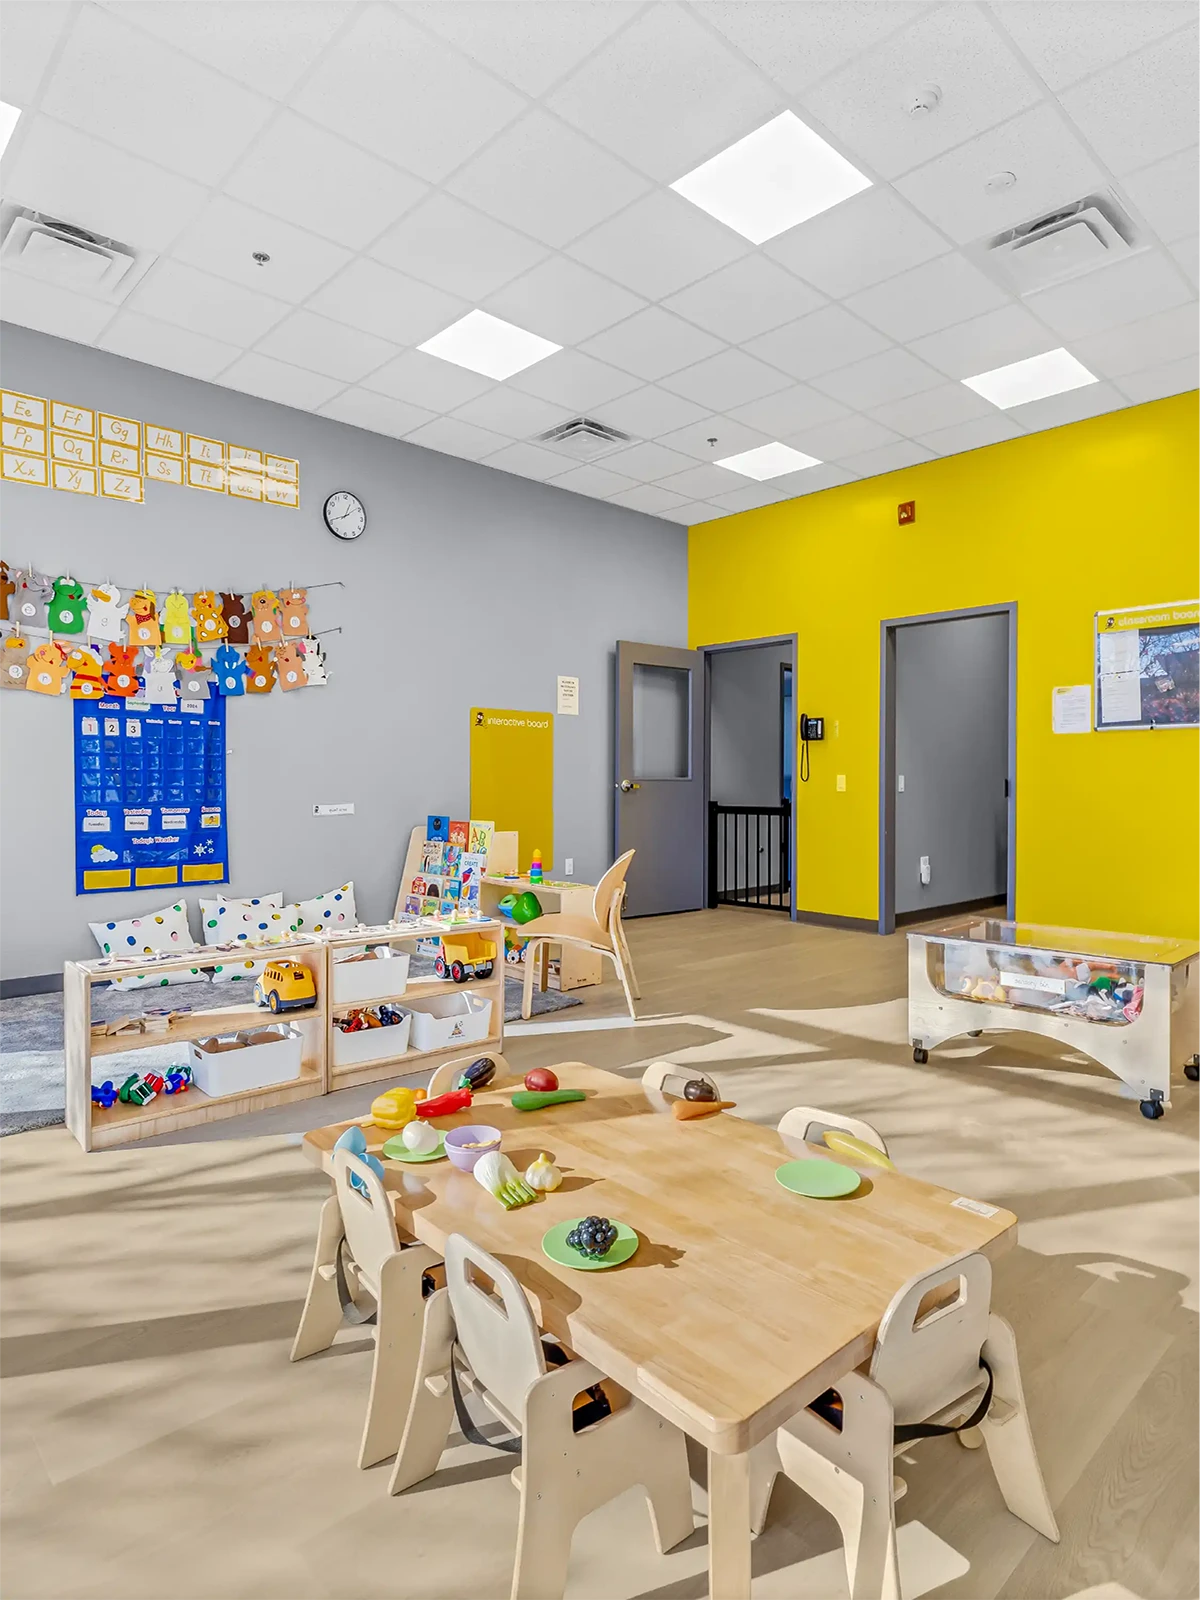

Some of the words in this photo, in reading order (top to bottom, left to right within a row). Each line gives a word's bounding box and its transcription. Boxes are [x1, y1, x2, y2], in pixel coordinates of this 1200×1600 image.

[14, 400, 32, 417] Ee
[62, 410, 83, 426] Ff
[14, 426, 33, 448] Pp
[110, 421, 129, 442] Gg
[155, 432, 174, 449] Hh
[63, 439, 84, 462] Qq
[110, 449, 129, 465] Rr
[200, 444, 211, 458] Ii
[13, 459, 36, 477] Xx
[156, 461, 172, 476] Ss
[200, 468, 212, 483] Tt
[68, 468, 82, 490] Yy
[113, 478, 131, 493] Zz
[1118, 613, 1171, 627] classroom
[98, 701, 120, 709] Month
[88, 723, 92, 732] 1
[109, 724, 115, 733] 2
[130, 725, 136, 734] 3
[487, 717, 526, 727] interactive
[527, 719, 549, 729] board
[86, 809, 107, 817] Today
[123, 808, 152, 816] Yesterday
